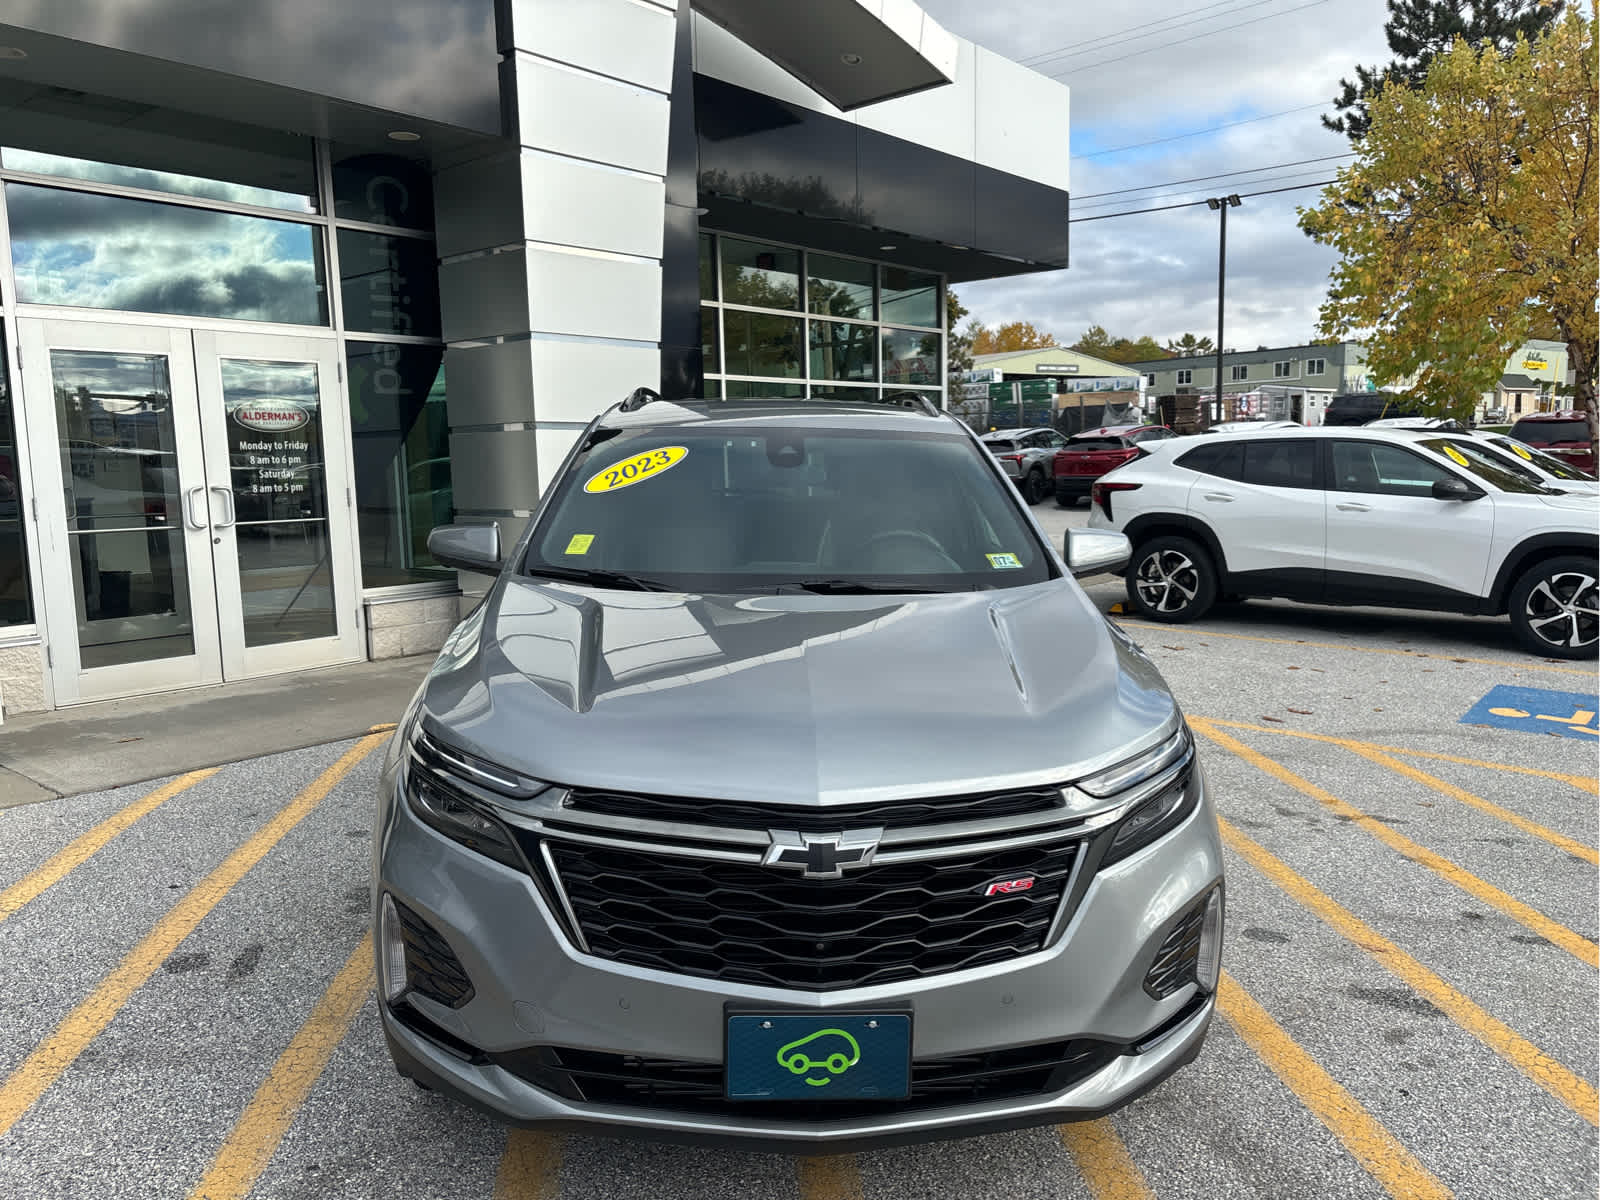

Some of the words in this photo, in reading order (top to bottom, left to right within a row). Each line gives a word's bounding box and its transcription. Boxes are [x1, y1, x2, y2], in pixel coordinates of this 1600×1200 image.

[242, 411, 302, 421] ALDERMAN'S
[240, 441, 272, 451] Monday
[274, 441, 282, 450] to
[284, 441, 308, 451] Friday
[250, 456, 255, 464] 8
[281, 455, 287, 463] 6
[288, 457, 301, 465] pm
[259, 469, 295, 479] Saturday
[604, 450, 672, 488] 2023
[252, 484, 258, 493] 8
[274, 484, 282, 492] to
[284, 483, 289, 491] 5
[291, 484, 303, 493] pm
[984, 877, 1035, 896] RS
